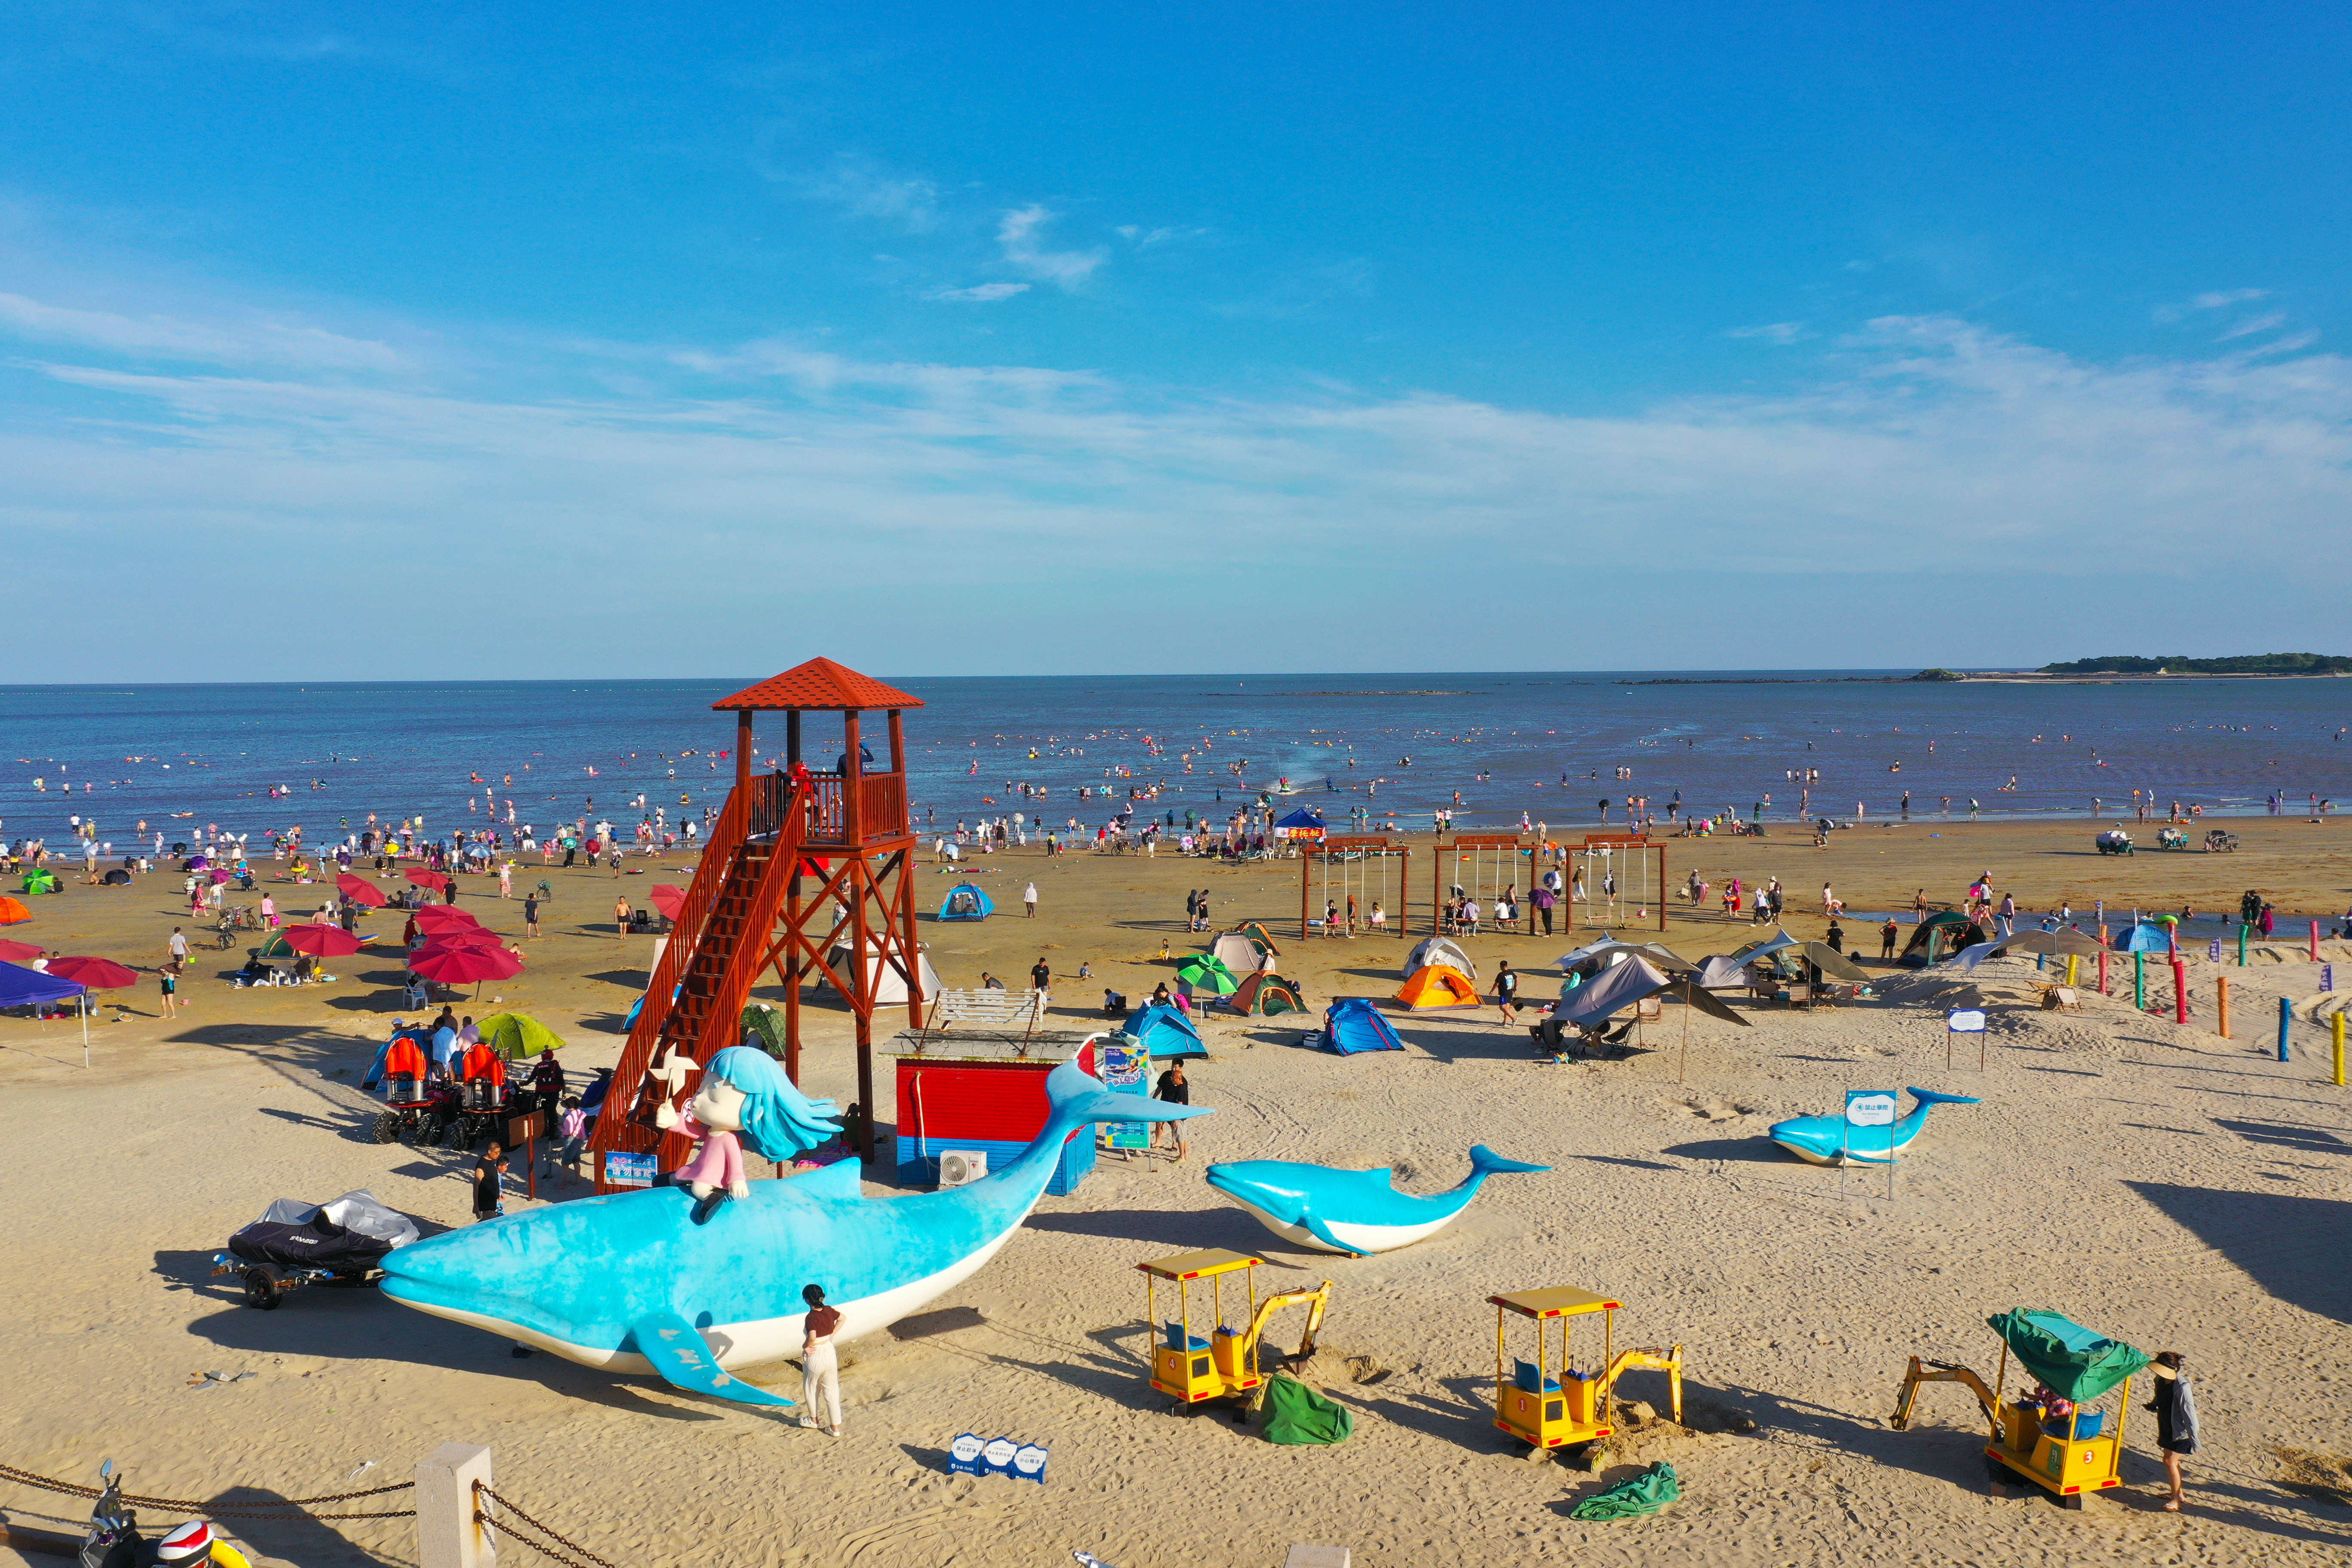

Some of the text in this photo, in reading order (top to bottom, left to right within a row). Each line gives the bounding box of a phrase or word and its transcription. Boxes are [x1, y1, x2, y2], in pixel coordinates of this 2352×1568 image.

[1289, 829, 1320, 838] 摩托艇
[612, 1167, 652, 1178] 请勿攀爬
[1170, 1358, 1174, 1369] 4
[1520, 1400, 1525, 1411] 1
[2085, 1451, 2092, 1463] 3
